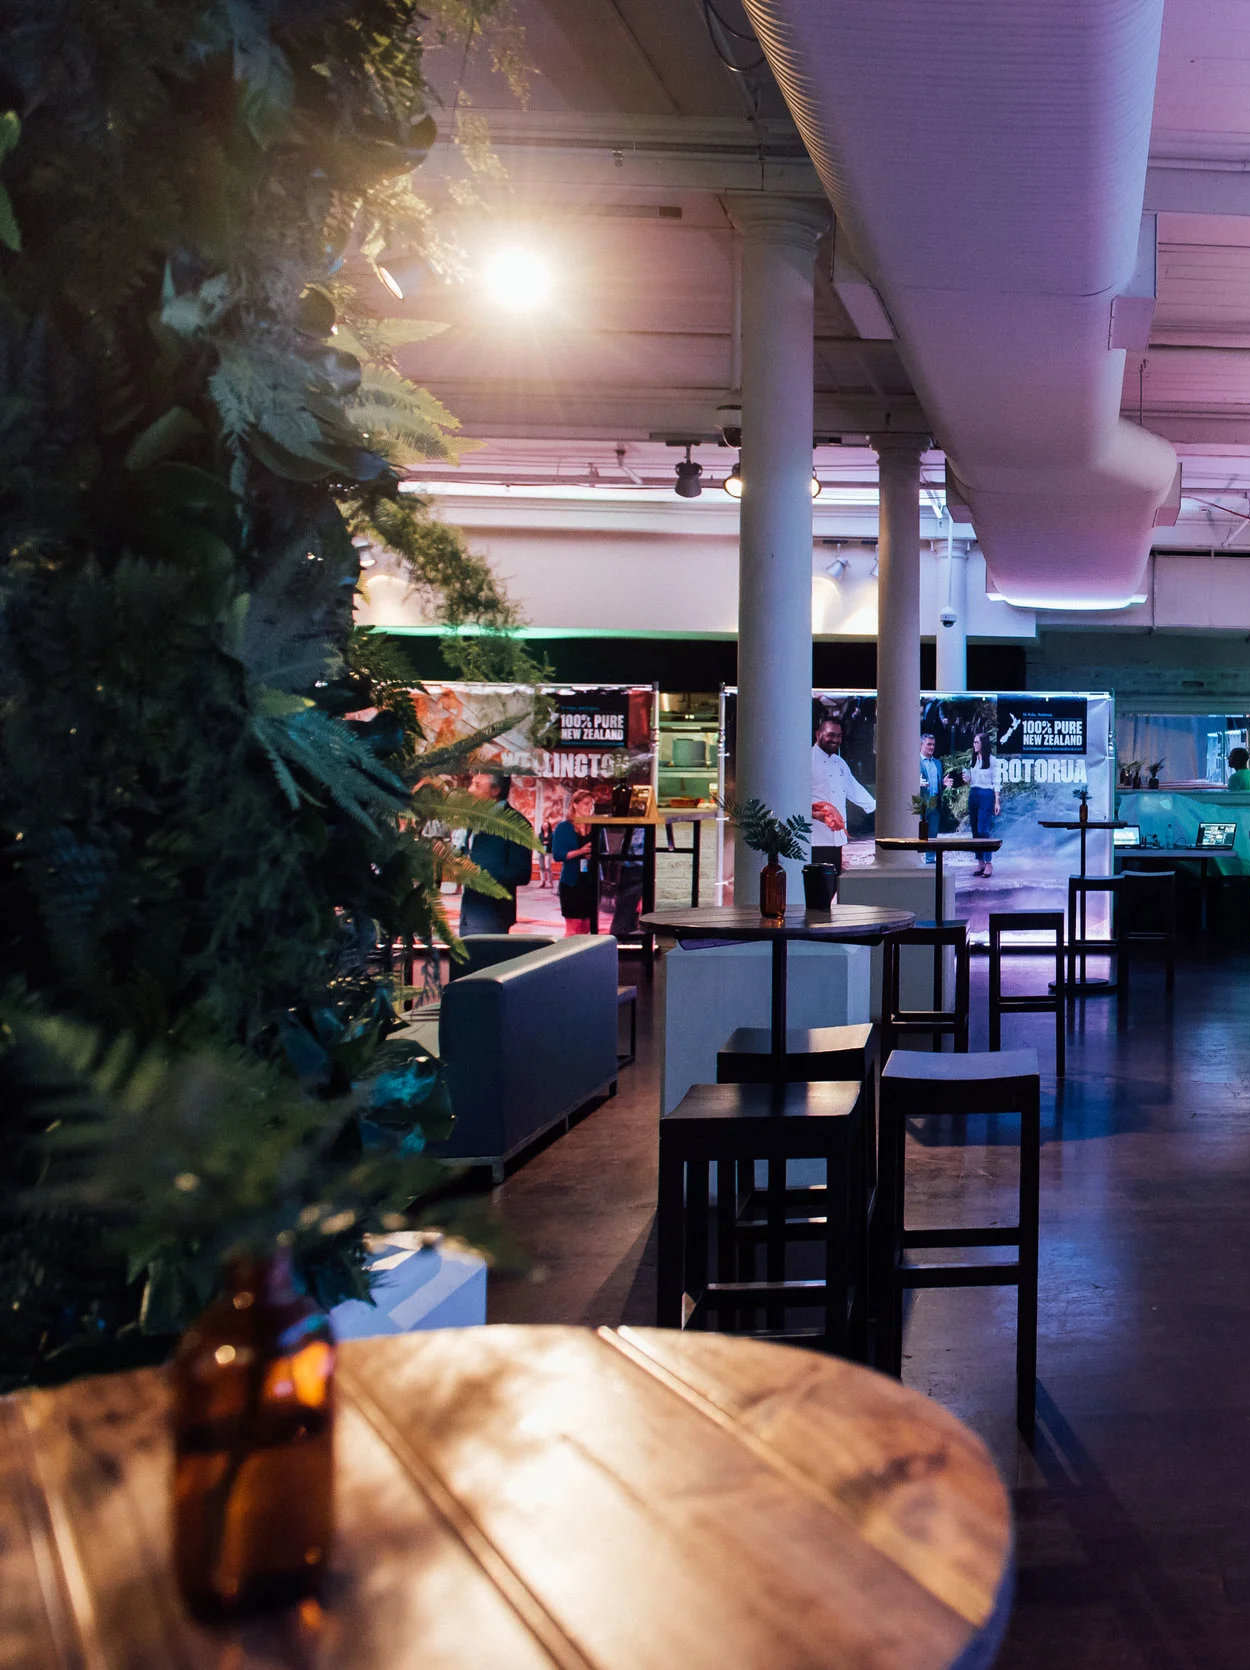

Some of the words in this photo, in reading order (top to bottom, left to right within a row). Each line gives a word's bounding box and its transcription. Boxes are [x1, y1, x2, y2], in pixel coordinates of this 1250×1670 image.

[560, 714, 593, 728] 100%
[594, 714, 625, 729] PURE
[1022, 720, 1052, 734] 100%
[1054, 720, 1083, 734] PURE
[561, 728, 582, 740] NEW
[583, 729, 624, 741] ZEALAND
[1023, 734, 1042, 746] NEW
[1043, 734, 1083, 746] ZEALAND
[997, 758, 1088, 783] ROTORUA
